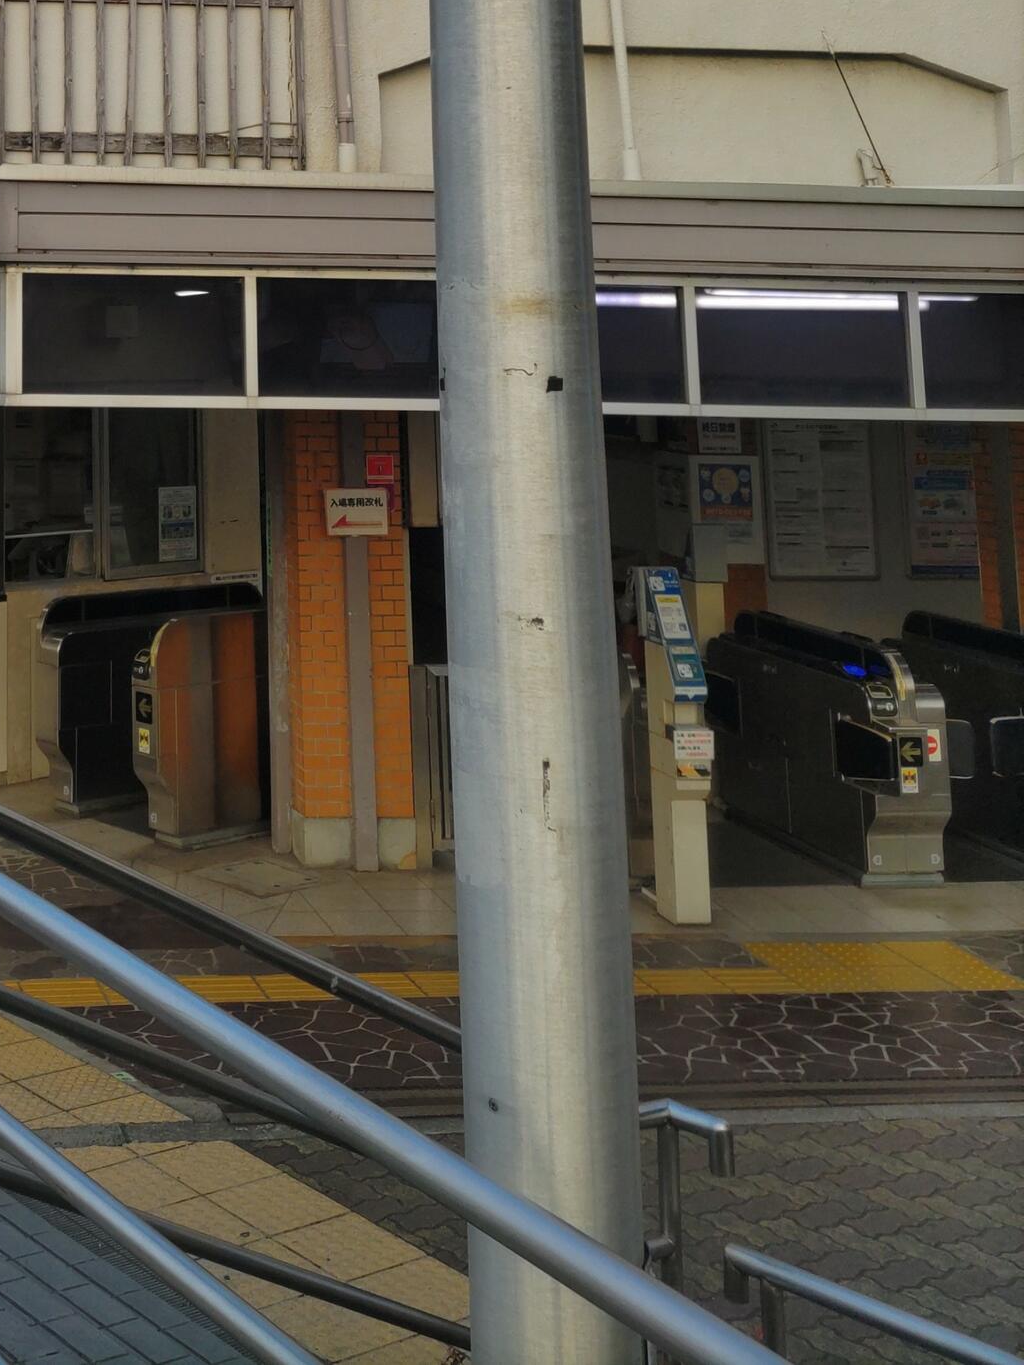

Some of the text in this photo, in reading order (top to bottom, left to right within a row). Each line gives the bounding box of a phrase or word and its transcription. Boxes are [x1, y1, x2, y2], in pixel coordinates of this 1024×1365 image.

[330, 497, 384, 508] 入場専用改札
